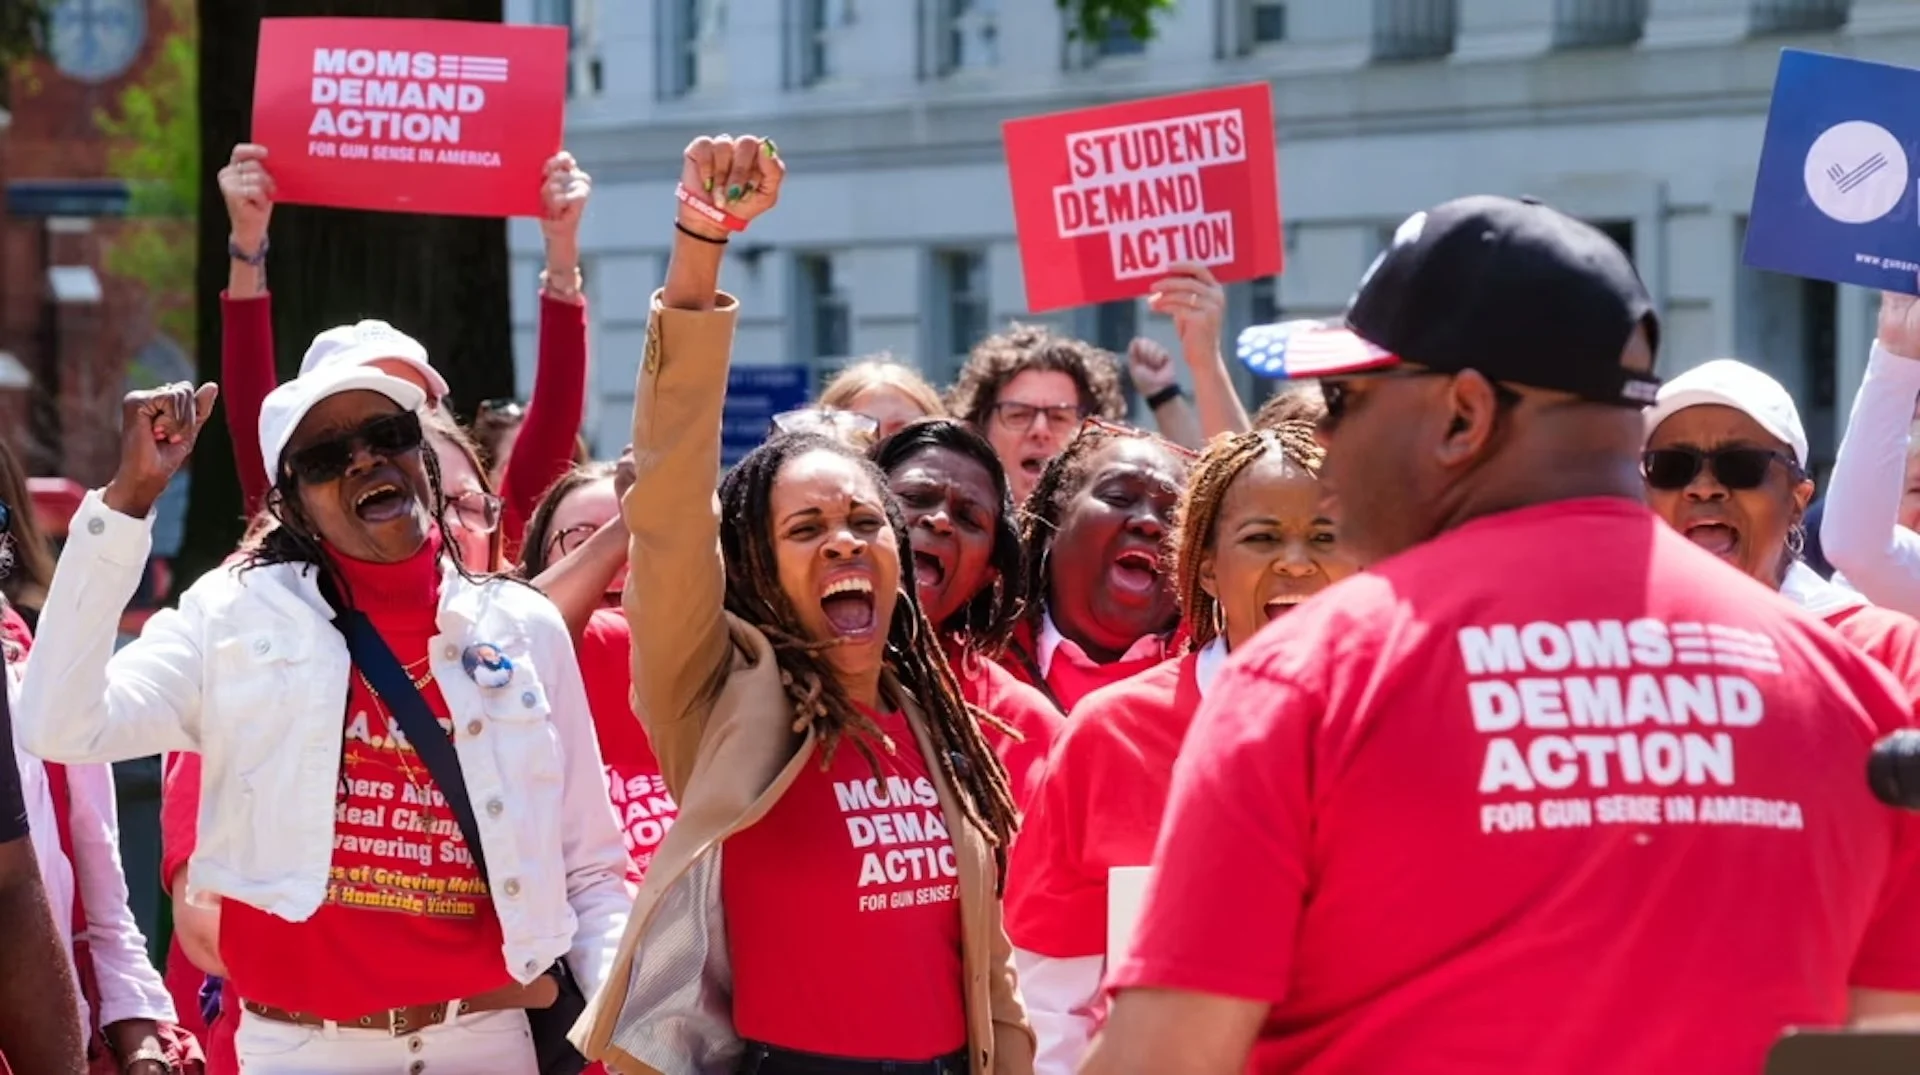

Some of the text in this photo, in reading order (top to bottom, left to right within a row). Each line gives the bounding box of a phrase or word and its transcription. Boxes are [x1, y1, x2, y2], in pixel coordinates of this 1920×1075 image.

[313, 48, 436, 79] MOMS
[311, 78, 485, 112] DEMAND
[309, 108, 461, 144] ACTION
[308, 141, 501, 167] FOR GUN SENSE IN AMERICA
[1072, 116, 1242, 179] STUDENTS
[1059, 173, 1199, 231] DEMAND
[1120, 218, 1230, 273] ACTION
[1457, 618, 1674, 675] MOMS
[1467, 673, 1764, 732] DEMAND
[1478, 731, 1735, 793] ACTION
[401, 779, 450, 807] Adv
[833, 776, 939, 812] MOMS
[846, 810, 950, 848] DEMA
[1481, 794, 1804, 834] FOR GUN SENSE IN AMERICA
[348, 865, 370, 881] of
[374, 868, 446, 894] Grieving
[341, 886, 424, 912] Homicide
[426, 896, 476, 914] Victims
[859, 893, 887, 912] FOR
[891, 890, 914, 909] GUN
[916, 885, 952, 905] SENSE
